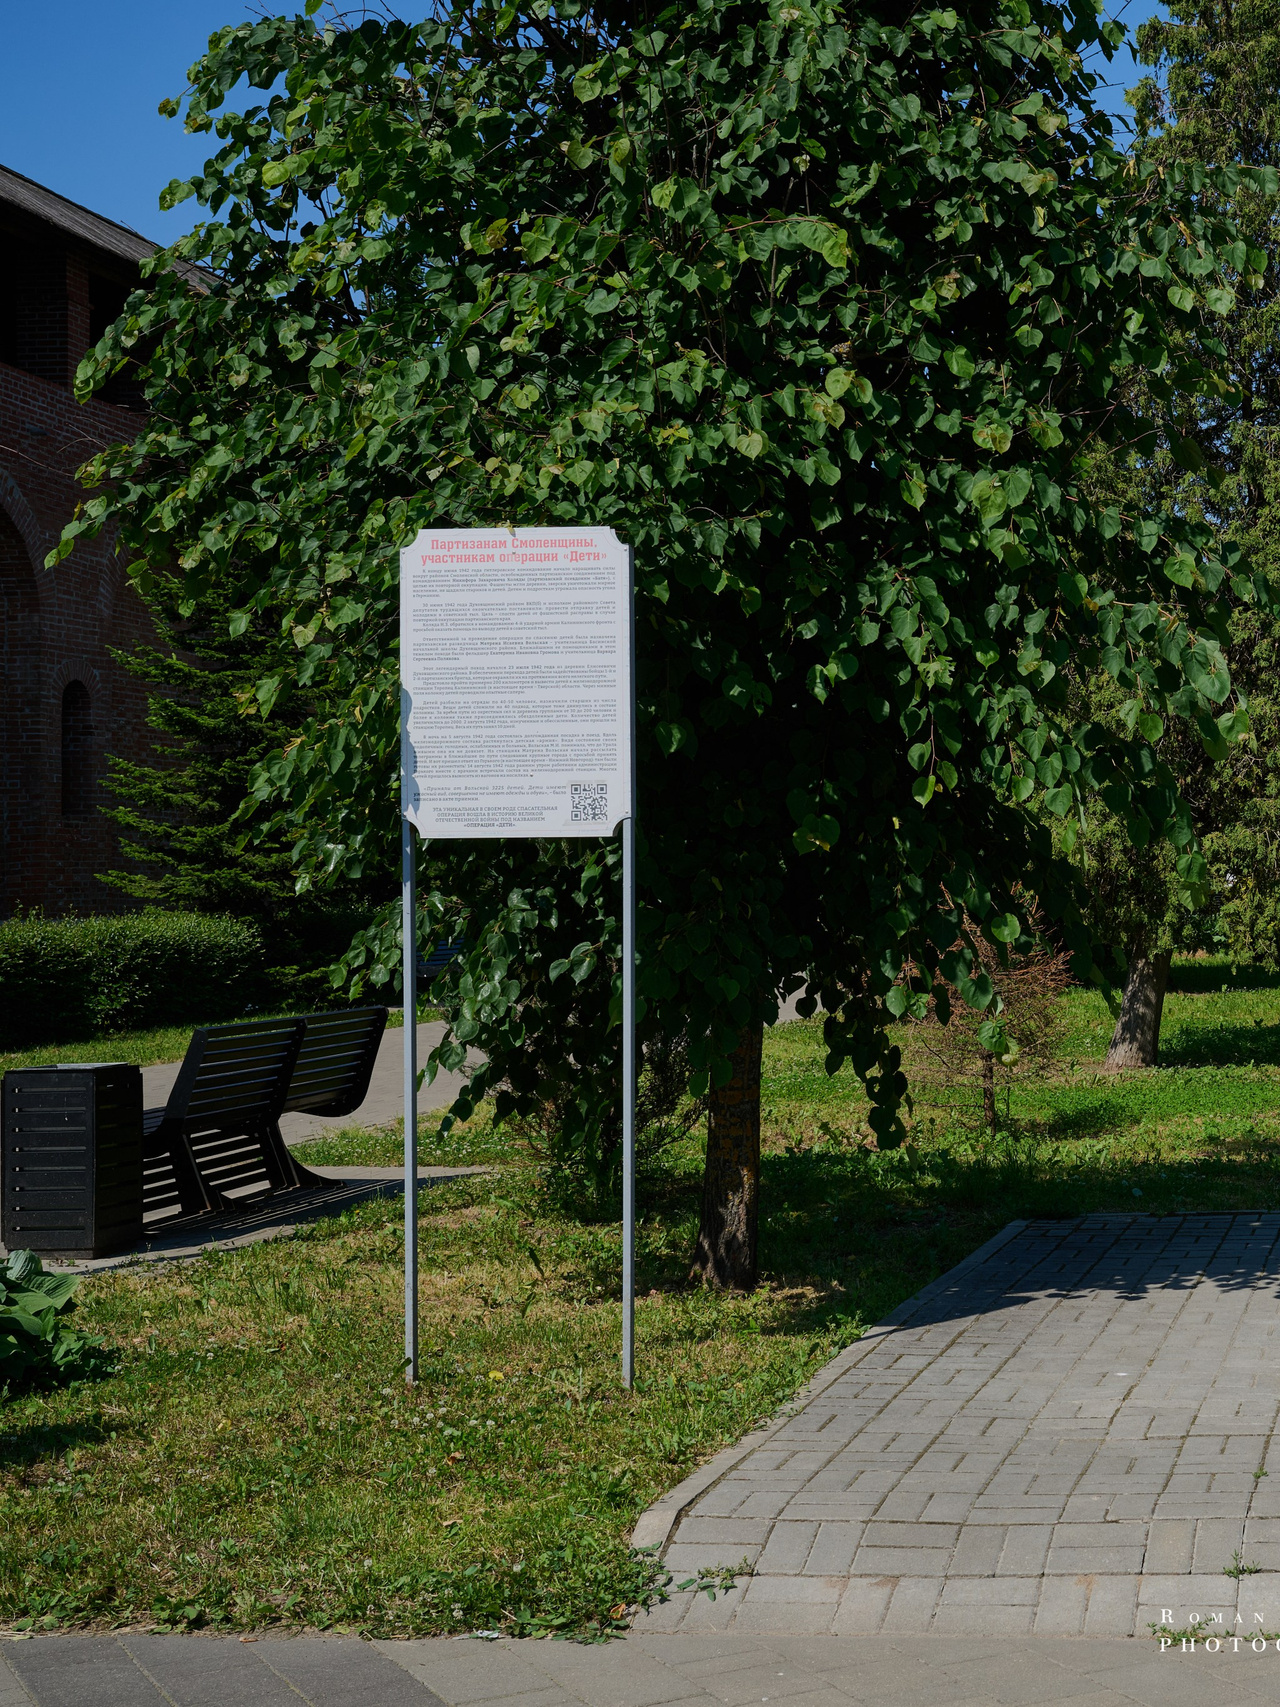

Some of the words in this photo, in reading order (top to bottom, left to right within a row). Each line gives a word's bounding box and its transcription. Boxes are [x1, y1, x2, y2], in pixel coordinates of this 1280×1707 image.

[431, 540, 507, 552] Партизанам
[421, 554, 495, 566] участникам
[499, 552, 558, 564] операции
[564, 551, 606, 562] «Дети»
